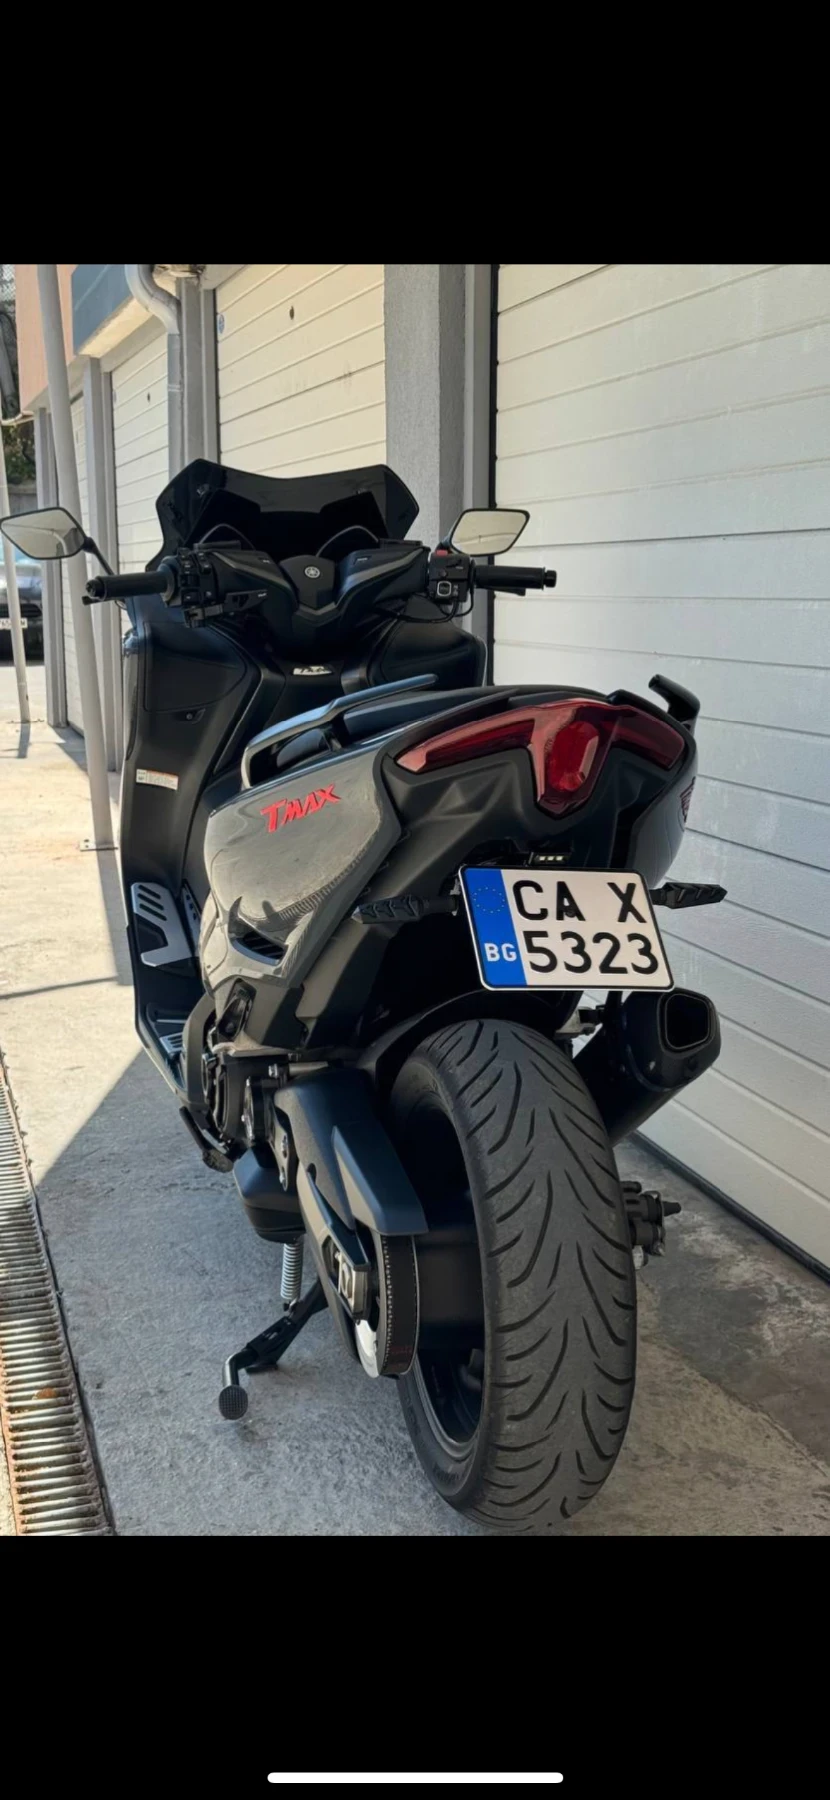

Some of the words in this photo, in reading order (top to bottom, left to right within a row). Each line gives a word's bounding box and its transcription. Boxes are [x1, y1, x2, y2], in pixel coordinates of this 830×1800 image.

[260, 782, 341, 833] TMAX
[512, 880, 586, 921] CA
[607, 882, 647, 923] X
[484, 943, 517, 962] BG
[522, 930, 659, 975] 5323
